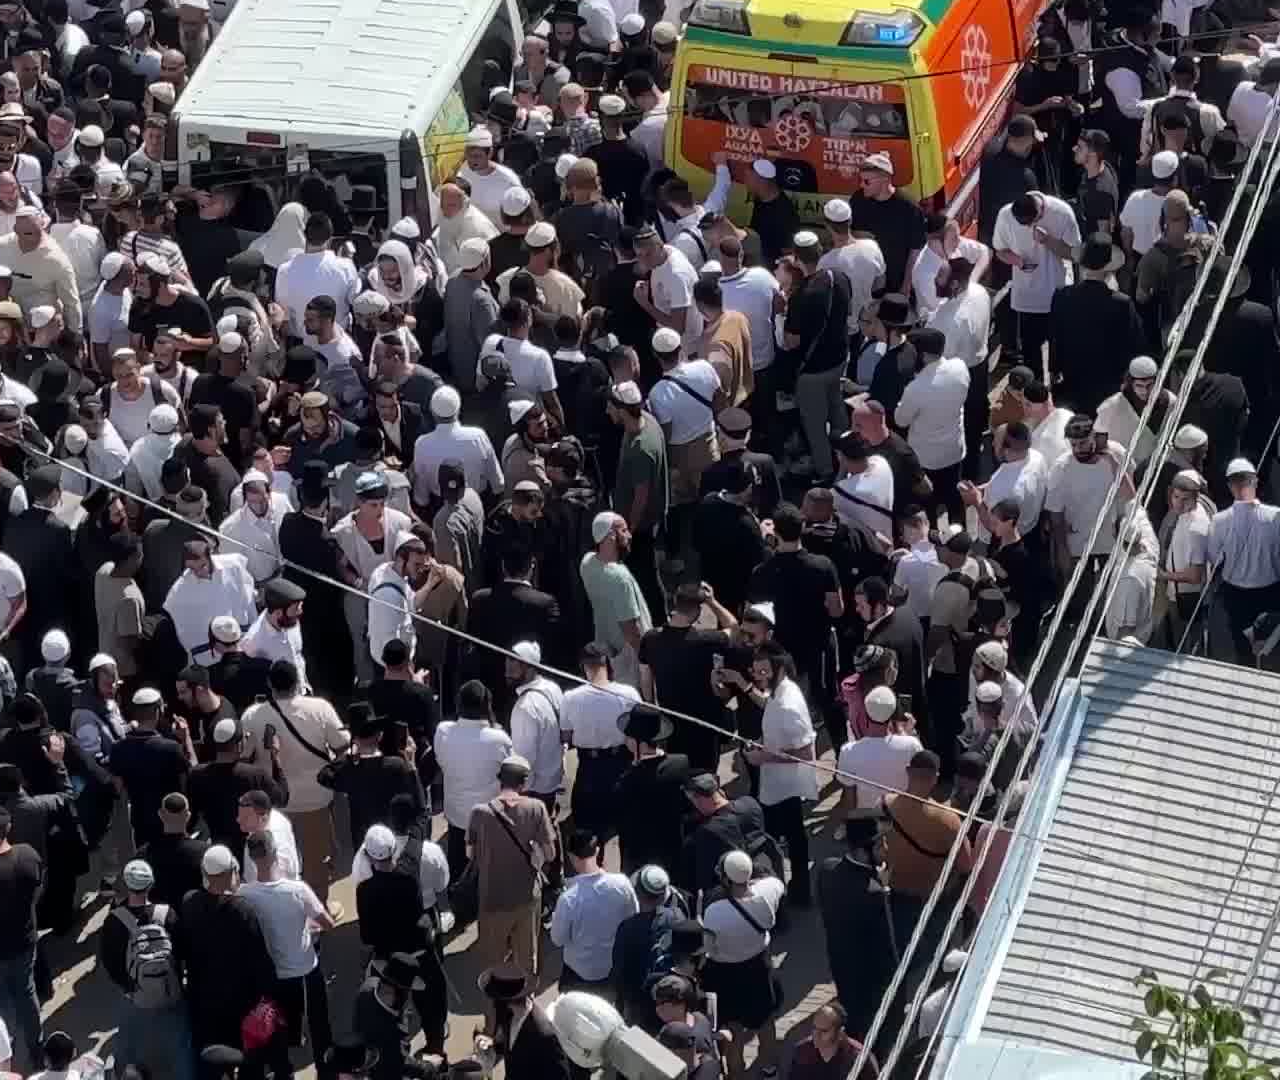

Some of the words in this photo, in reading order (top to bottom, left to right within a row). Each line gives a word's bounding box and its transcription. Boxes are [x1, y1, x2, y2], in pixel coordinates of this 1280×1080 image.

[704, 67, 771, 89] UNITED
[780, 77, 884, 101] HATZALAH
[823, 137, 868, 152] איחוד
